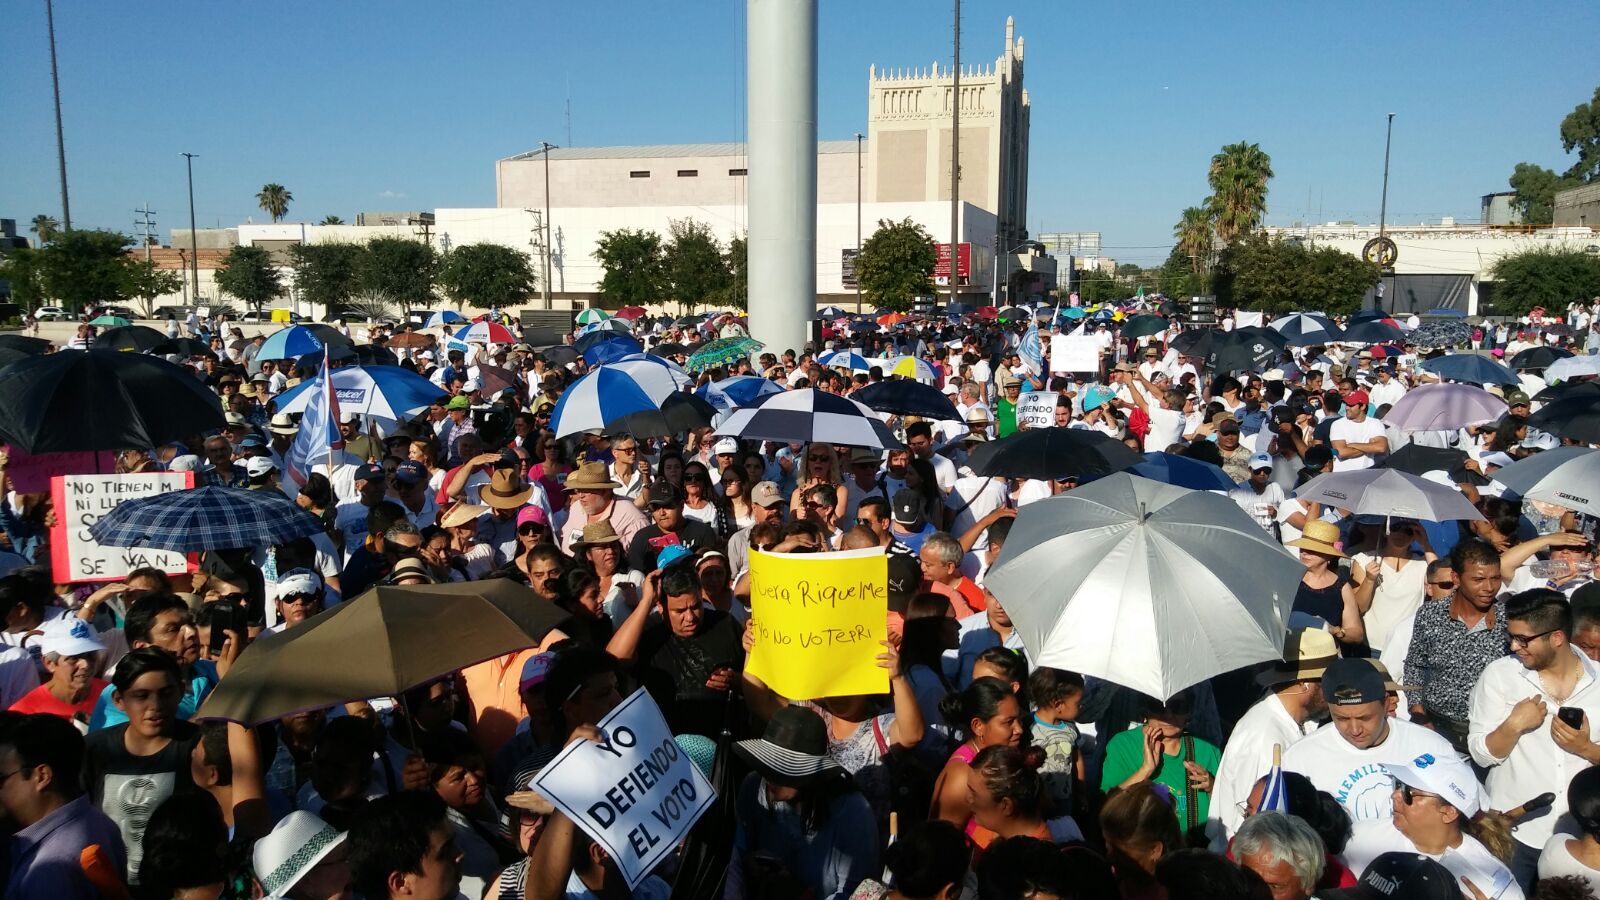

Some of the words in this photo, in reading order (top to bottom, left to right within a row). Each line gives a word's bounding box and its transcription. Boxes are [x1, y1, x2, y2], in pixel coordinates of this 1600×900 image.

[1028, 394, 1039, 403] YO
[73, 481, 95, 495] NO
[102, 481, 152, 494] TIENEN
[80, 557, 106, 575] SE
[596, 725, 637, 759] YO
[586, 738, 678, 830] DEFIENDO
[627, 822, 661, 860] EL
[651, 778, 698, 830] VOTO
[1365, 870, 1396, 896] PUMA
